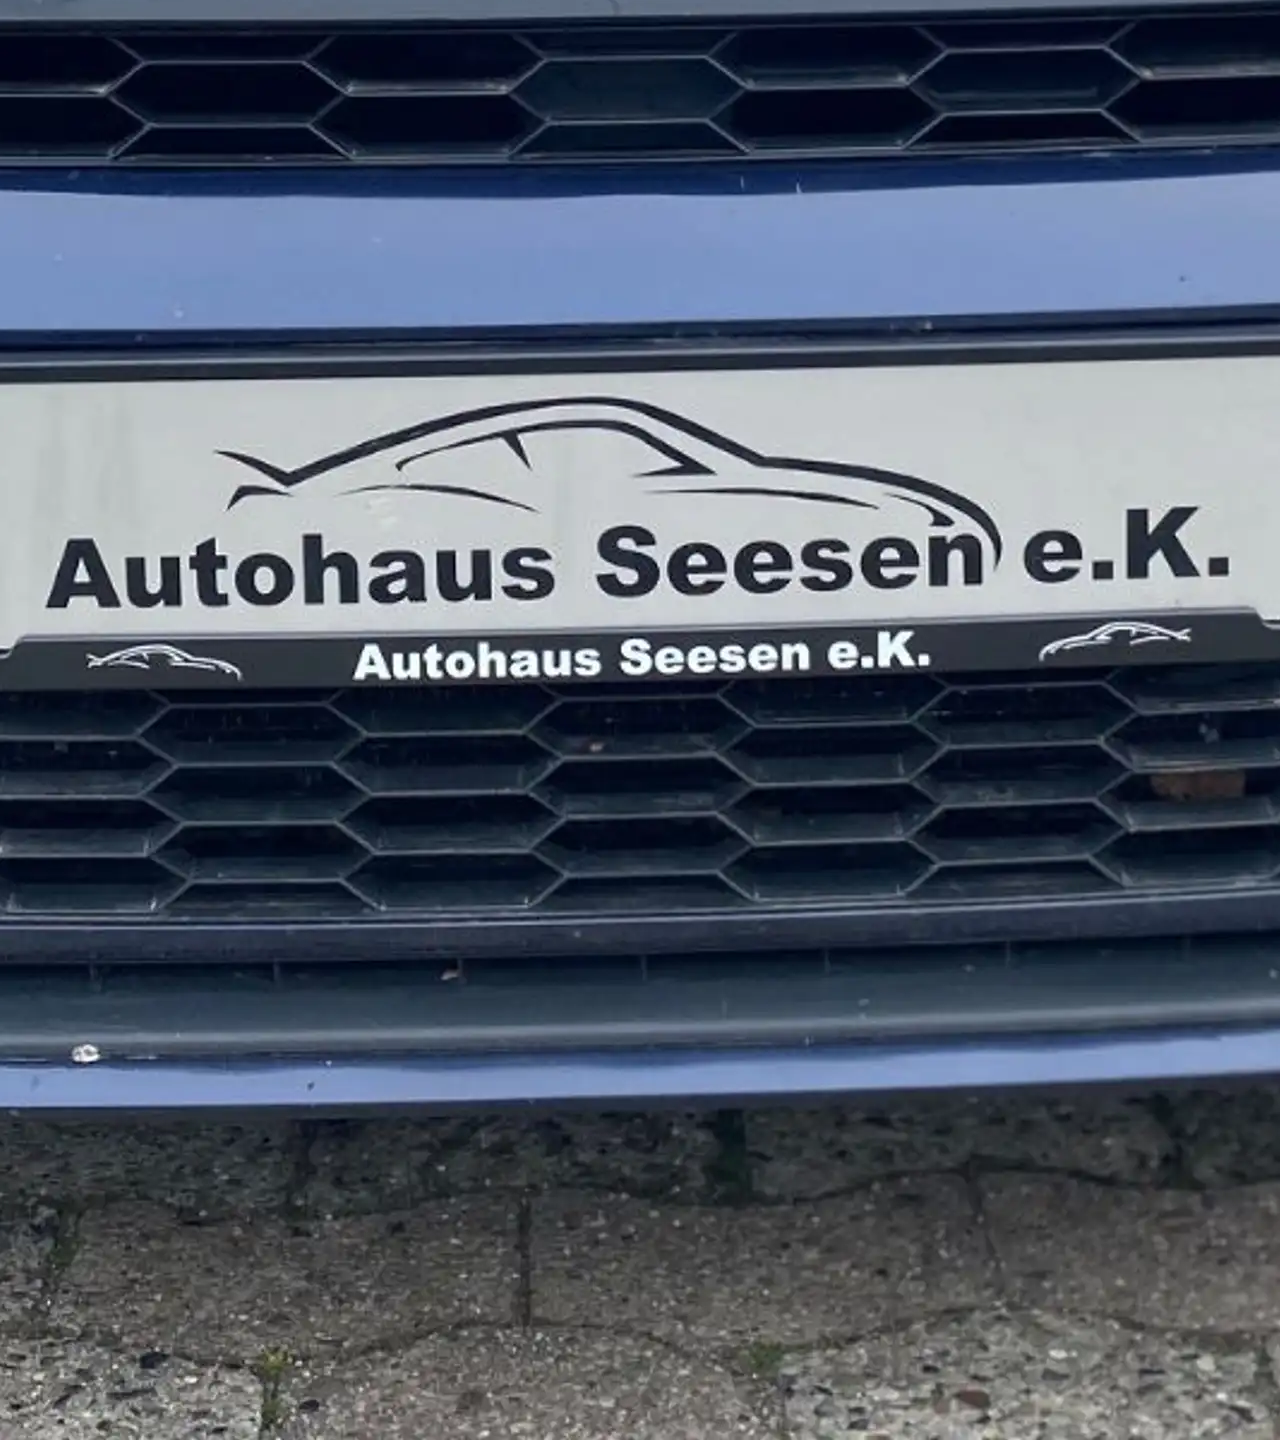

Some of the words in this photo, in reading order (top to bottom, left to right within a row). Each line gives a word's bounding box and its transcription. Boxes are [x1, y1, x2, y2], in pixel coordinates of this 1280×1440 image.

[45, 533, 555, 609] Autohaus
[596, 525, 983, 598] Seesen
[1023, 506, 1229, 584] e.K.
[353, 641, 602, 680] Autohaus
[620, 638, 810, 676] Seesen
[827, 630, 930, 669] e.K.
